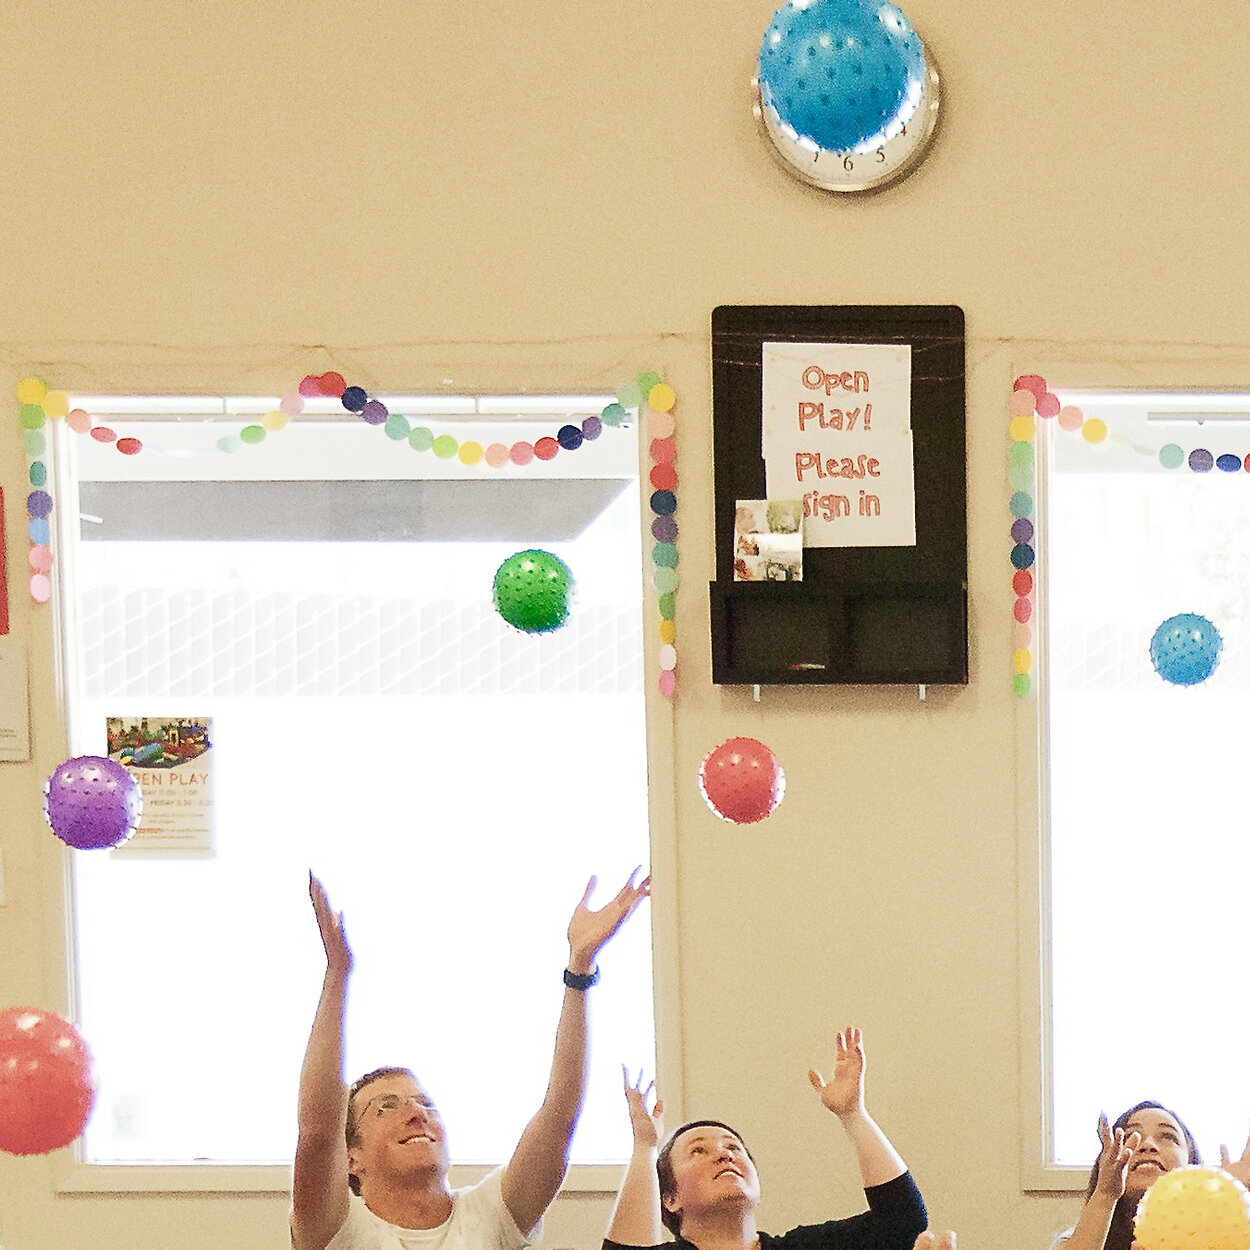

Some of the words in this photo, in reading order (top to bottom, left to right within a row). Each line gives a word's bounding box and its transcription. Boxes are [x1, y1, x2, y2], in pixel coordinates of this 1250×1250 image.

[843, 155, 854, 172] 6
[876, 147, 886, 163] 5
[801, 365, 870, 396] Open
[798, 402, 872, 431] Play!
[795, 452, 881, 482] Please
[858, 489, 881, 516] in
[169, 772, 209, 785] PLAY
